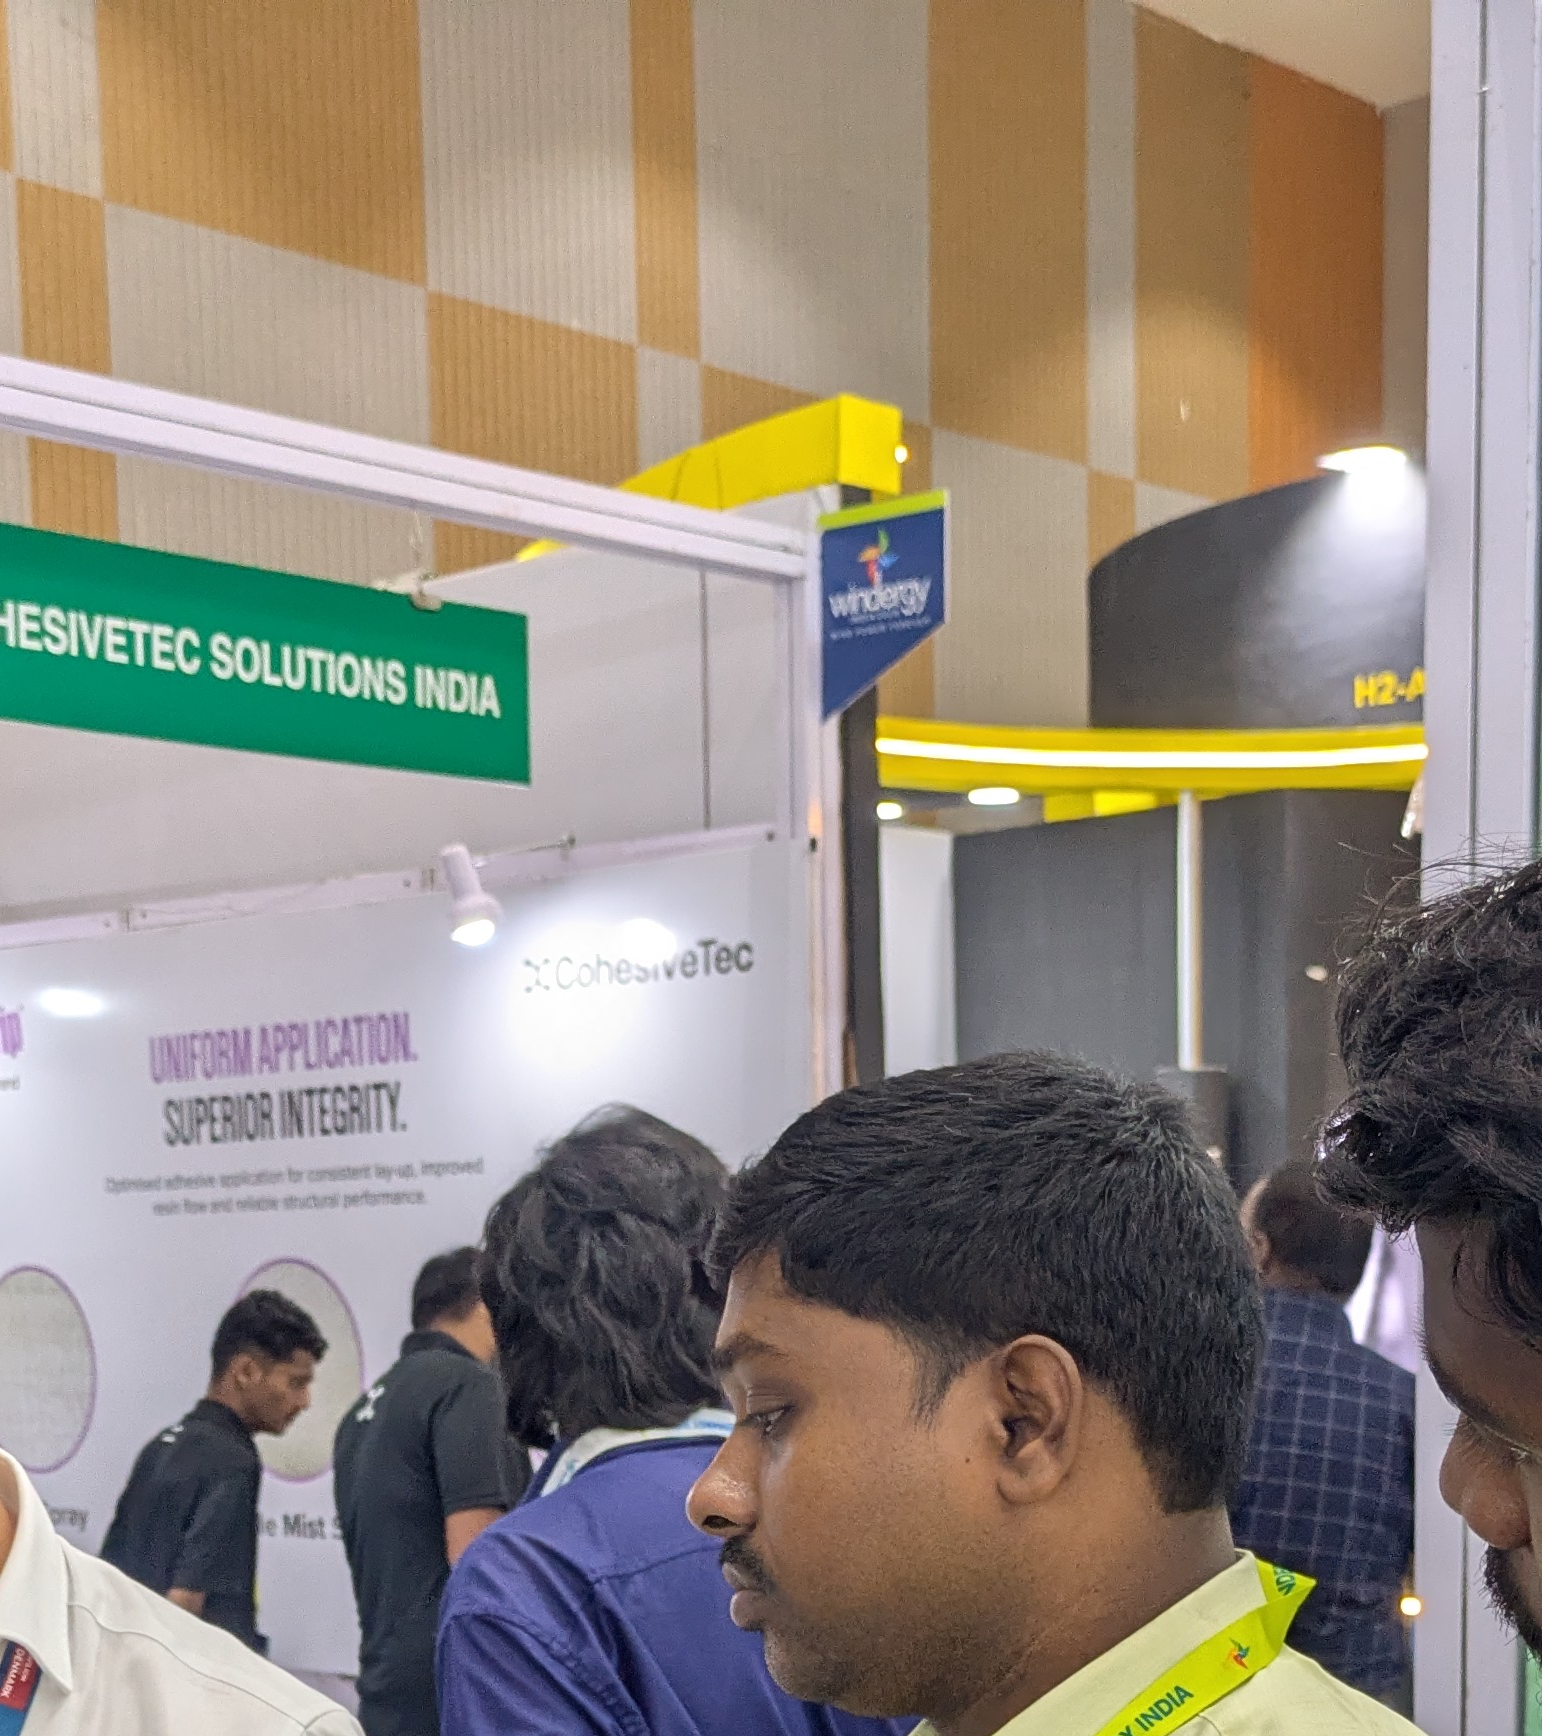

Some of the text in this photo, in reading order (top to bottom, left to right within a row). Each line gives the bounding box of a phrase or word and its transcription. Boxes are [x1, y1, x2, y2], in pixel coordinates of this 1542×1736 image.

[210, 633, 408, 704] SOLUTIONS
[414, 663, 501, 719] INDIA
[556, 937, 755, 990] CohesiveTec
[149, 1011, 418, 1084] UNIFORM APPLICATION.
[164, 1080, 408, 1147] SUPERIOR INTEGRITY.
[220, 1168, 284, 1190] application
[307, 1162, 371, 1183] consistent
[421, 1156, 485, 1178] improved
[282, 1513, 326, 1539] Mist
[0, 1648, 26, 1698] DENMARK
[1134, 1685, 1194, 1732] INDIA
